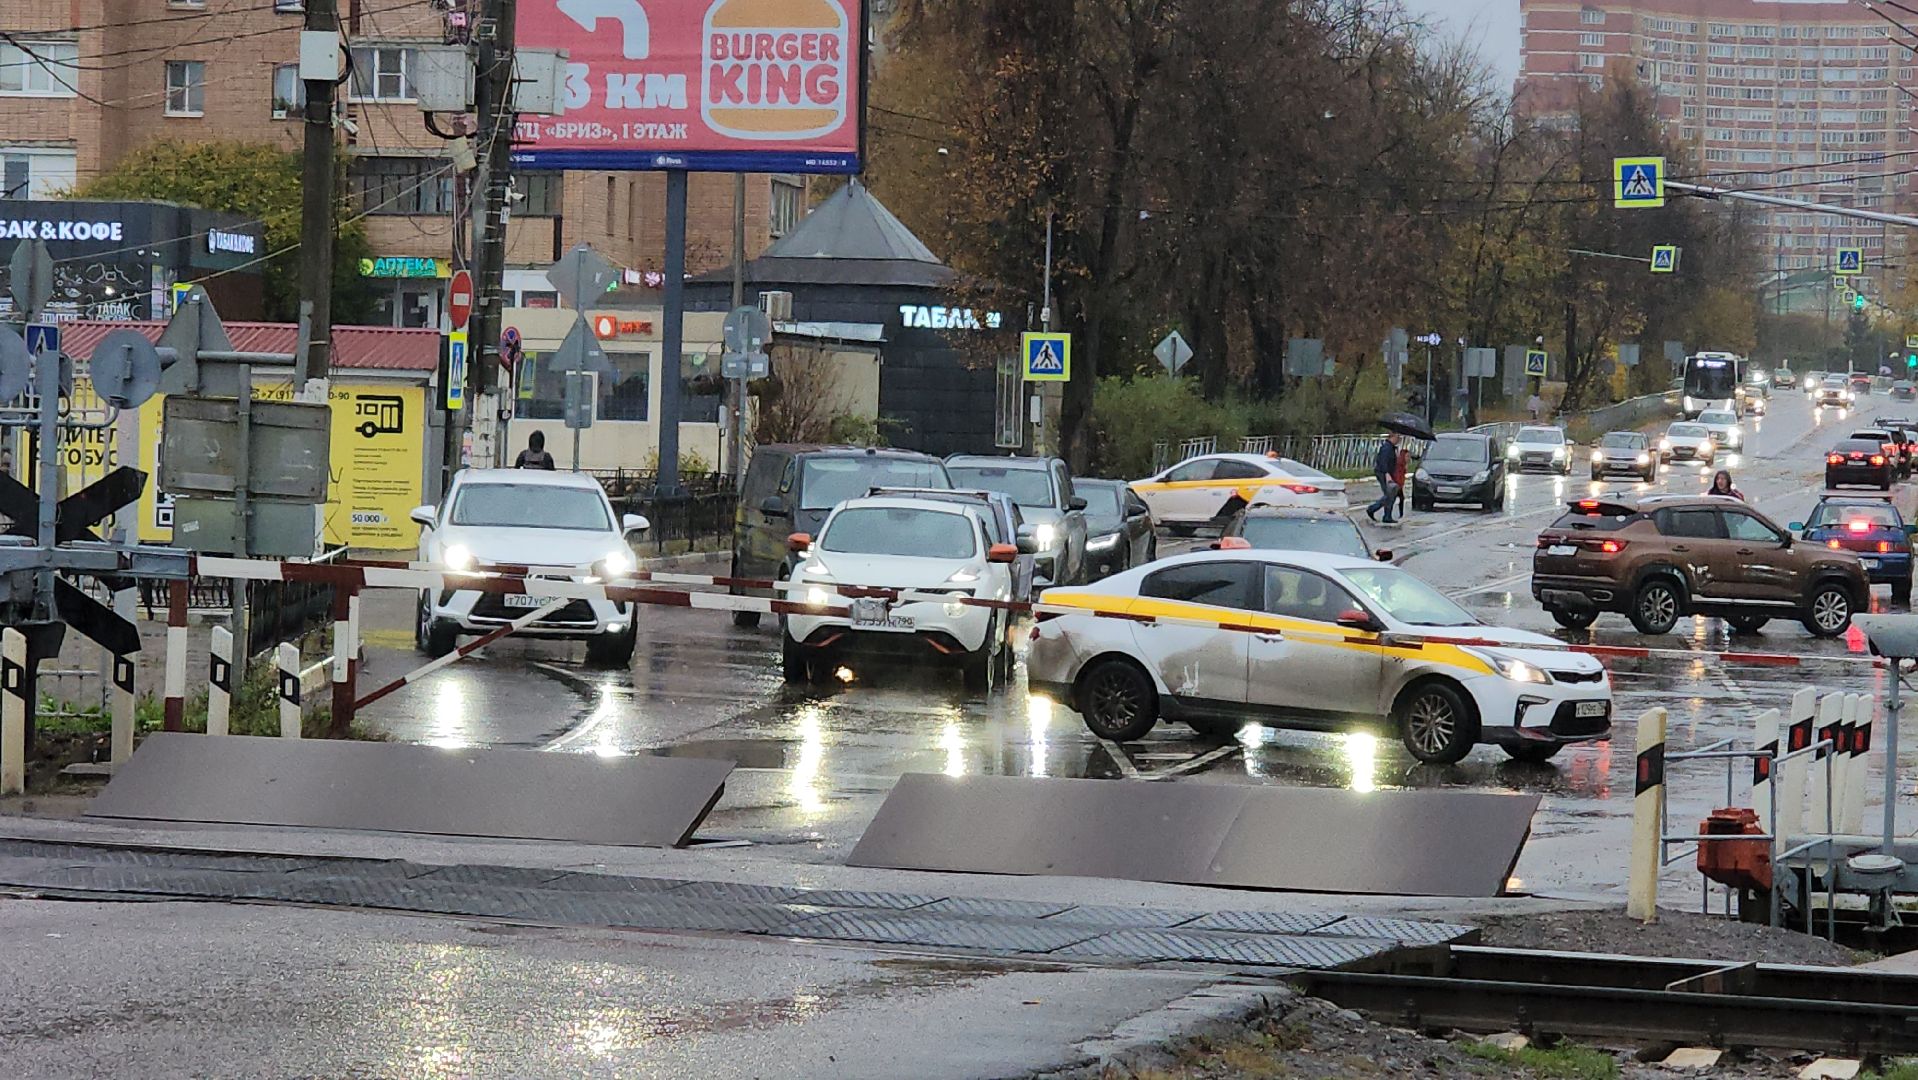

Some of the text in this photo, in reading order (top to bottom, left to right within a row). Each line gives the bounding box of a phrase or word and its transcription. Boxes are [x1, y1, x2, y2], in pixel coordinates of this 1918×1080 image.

[710, 33, 840, 61] BURGER
[709, 63, 839, 105] KING
[545, 122, 618, 141] «БРИЗ»,
[633, 122, 688, 140] ЭТАЖ
[375, 258, 435, 270] АПТЕКА
